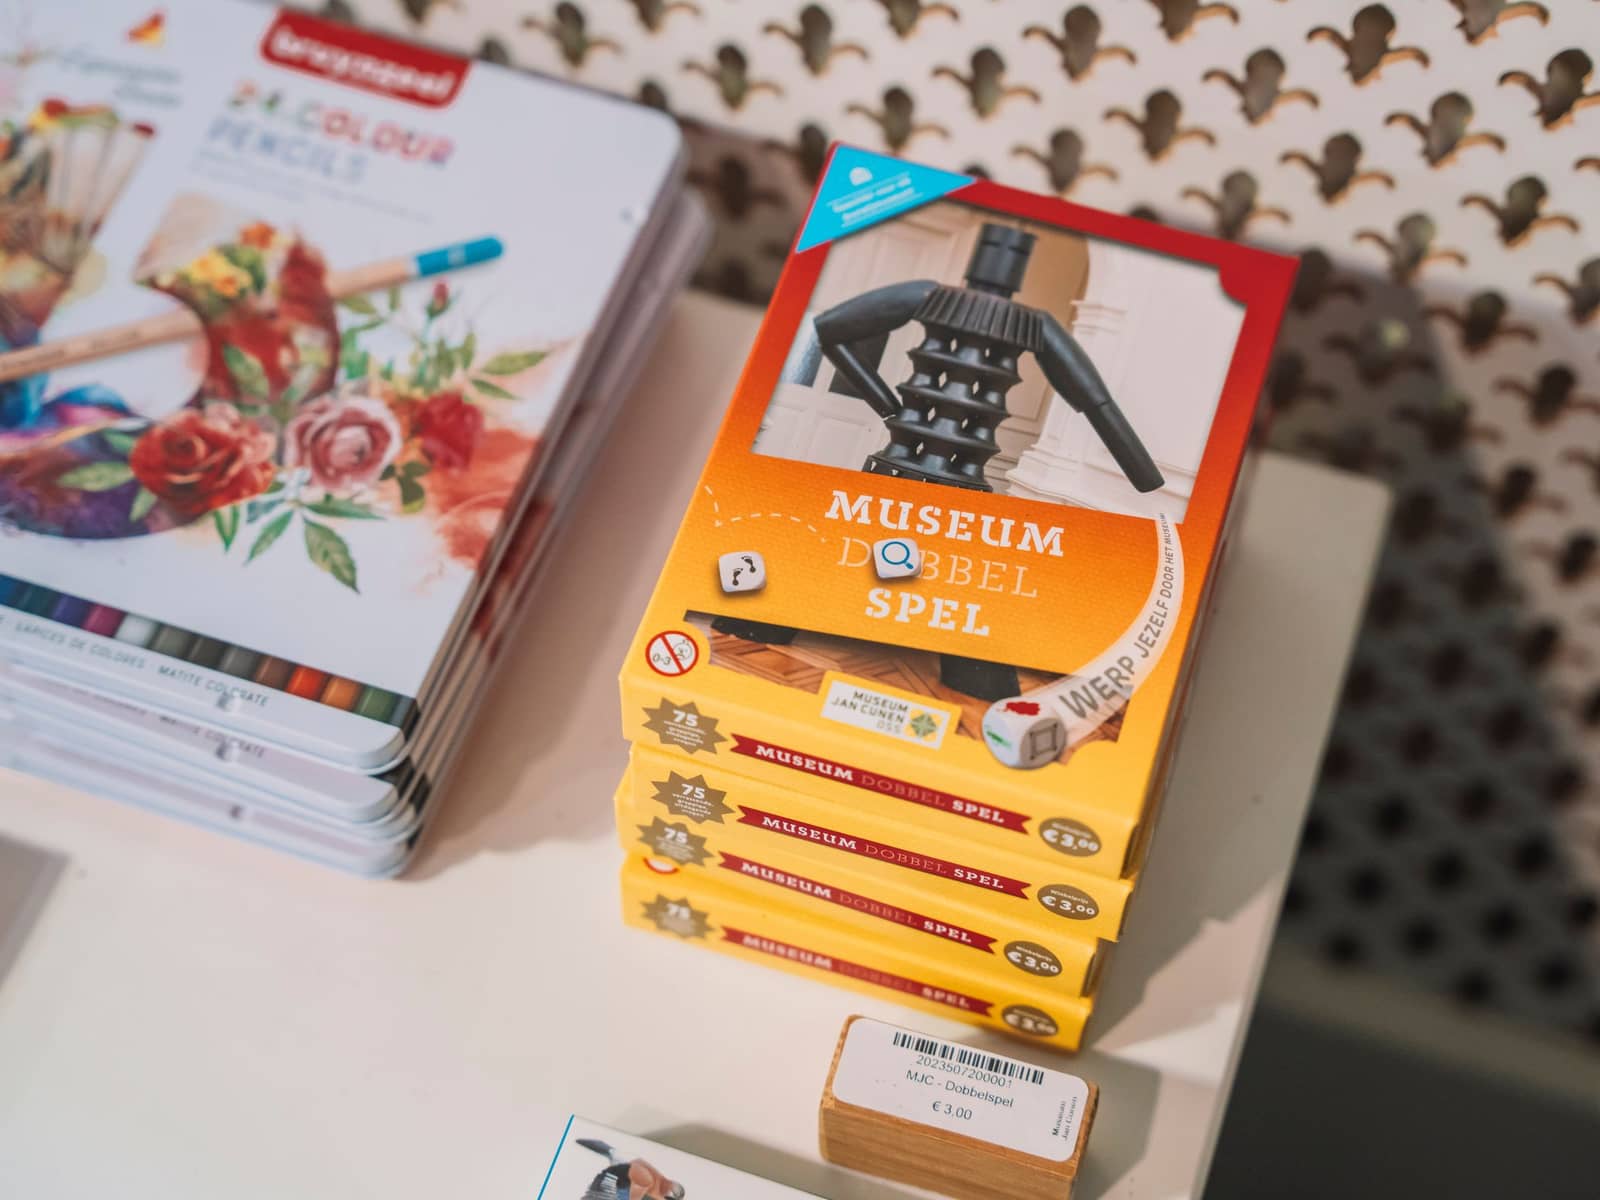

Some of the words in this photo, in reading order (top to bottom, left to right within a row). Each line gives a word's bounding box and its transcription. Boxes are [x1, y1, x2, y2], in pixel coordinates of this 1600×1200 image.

[206, 116, 367, 184] PENCILS
[296, 100, 456, 168] COLOUR
[824, 489, 1065, 557] MUSEUM
[836, 536, 1038, 598] DBBEL
[1164, 545, 1174, 566] HET
[1160, 567, 1174, 599] DOOR
[865, 587, 989, 637] SPEL
[1134, 599, 1169, 658] JEZELF
[90, 643, 145, 669] COLORES
[158, 664, 202, 687] MATITE
[1059, 656, 1135, 719] WERP
[672, 708, 699, 727] 75
[831, 696, 857, 710] JAN
[860, 703, 905, 723] CUNEN
[853, 690, 908, 712] MUSEUM
[681, 783, 706, 800] 75
[755, 744, 854, 781] MUSEUM
[861, 774, 946, 808] DOBBEL
[951, 799, 1005, 824] SPEL
[664, 826, 689, 845] 75
[762, 815, 858, 850] MUSEUM
[864, 844, 948, 874] DOBBEL
[953, 867, 1004, 889] SPEL
[741, 861, 832, 899] MUSEUM
[839, 892, 918, 927] DOBBEL
[923, 920, 973, 943] SPEL
[742, 934, 833, 969] MUSEUM
[921, 986, 971, 1009] SPEL
[906, 1069, 935, 1087] MJC
[945, 1079, 1015, 1108] Dobbelspel
[931, 1100, 942, 1112] €
[943, 1103, 973, 1121] 3,00
